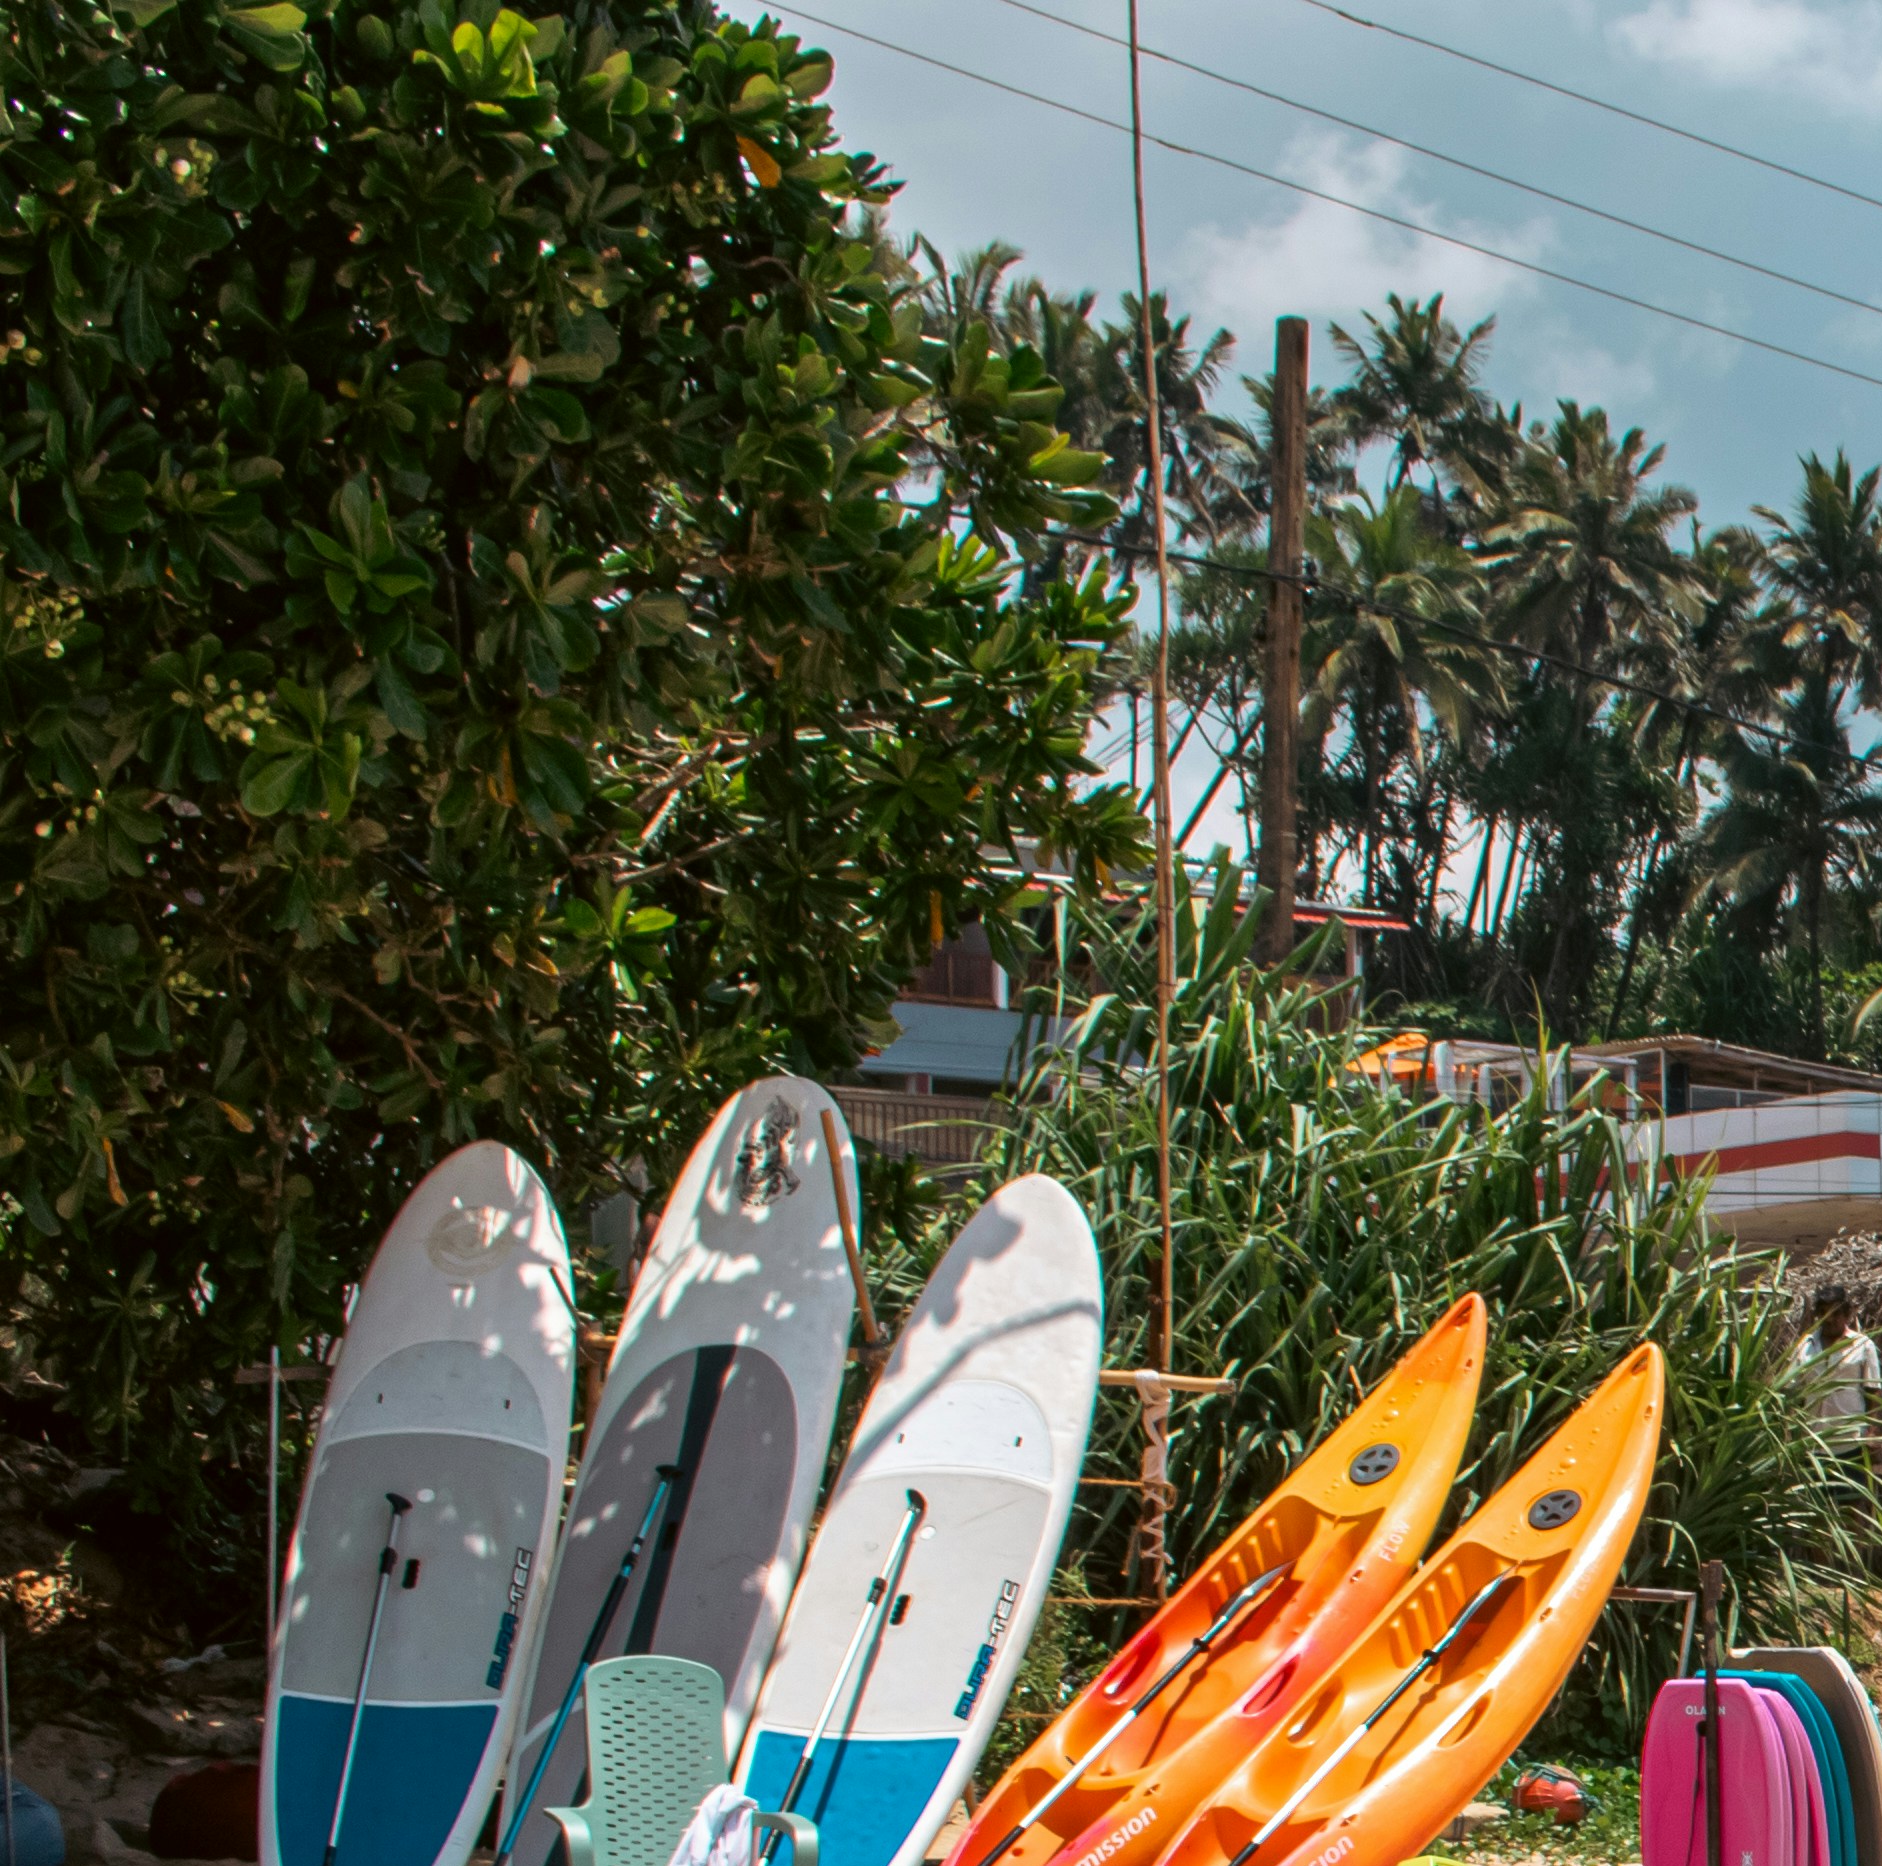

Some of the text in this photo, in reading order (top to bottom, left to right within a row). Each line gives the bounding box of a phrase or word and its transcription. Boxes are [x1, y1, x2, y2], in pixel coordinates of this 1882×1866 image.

[1378, 1518, 1411, 1563] FLOW
[485, 1547, 533, 1691] DURA-TEC
[953, 1579, 1020, 1720] DURA-TEC
[1685, 1704, 1726, 1716] OLAN
